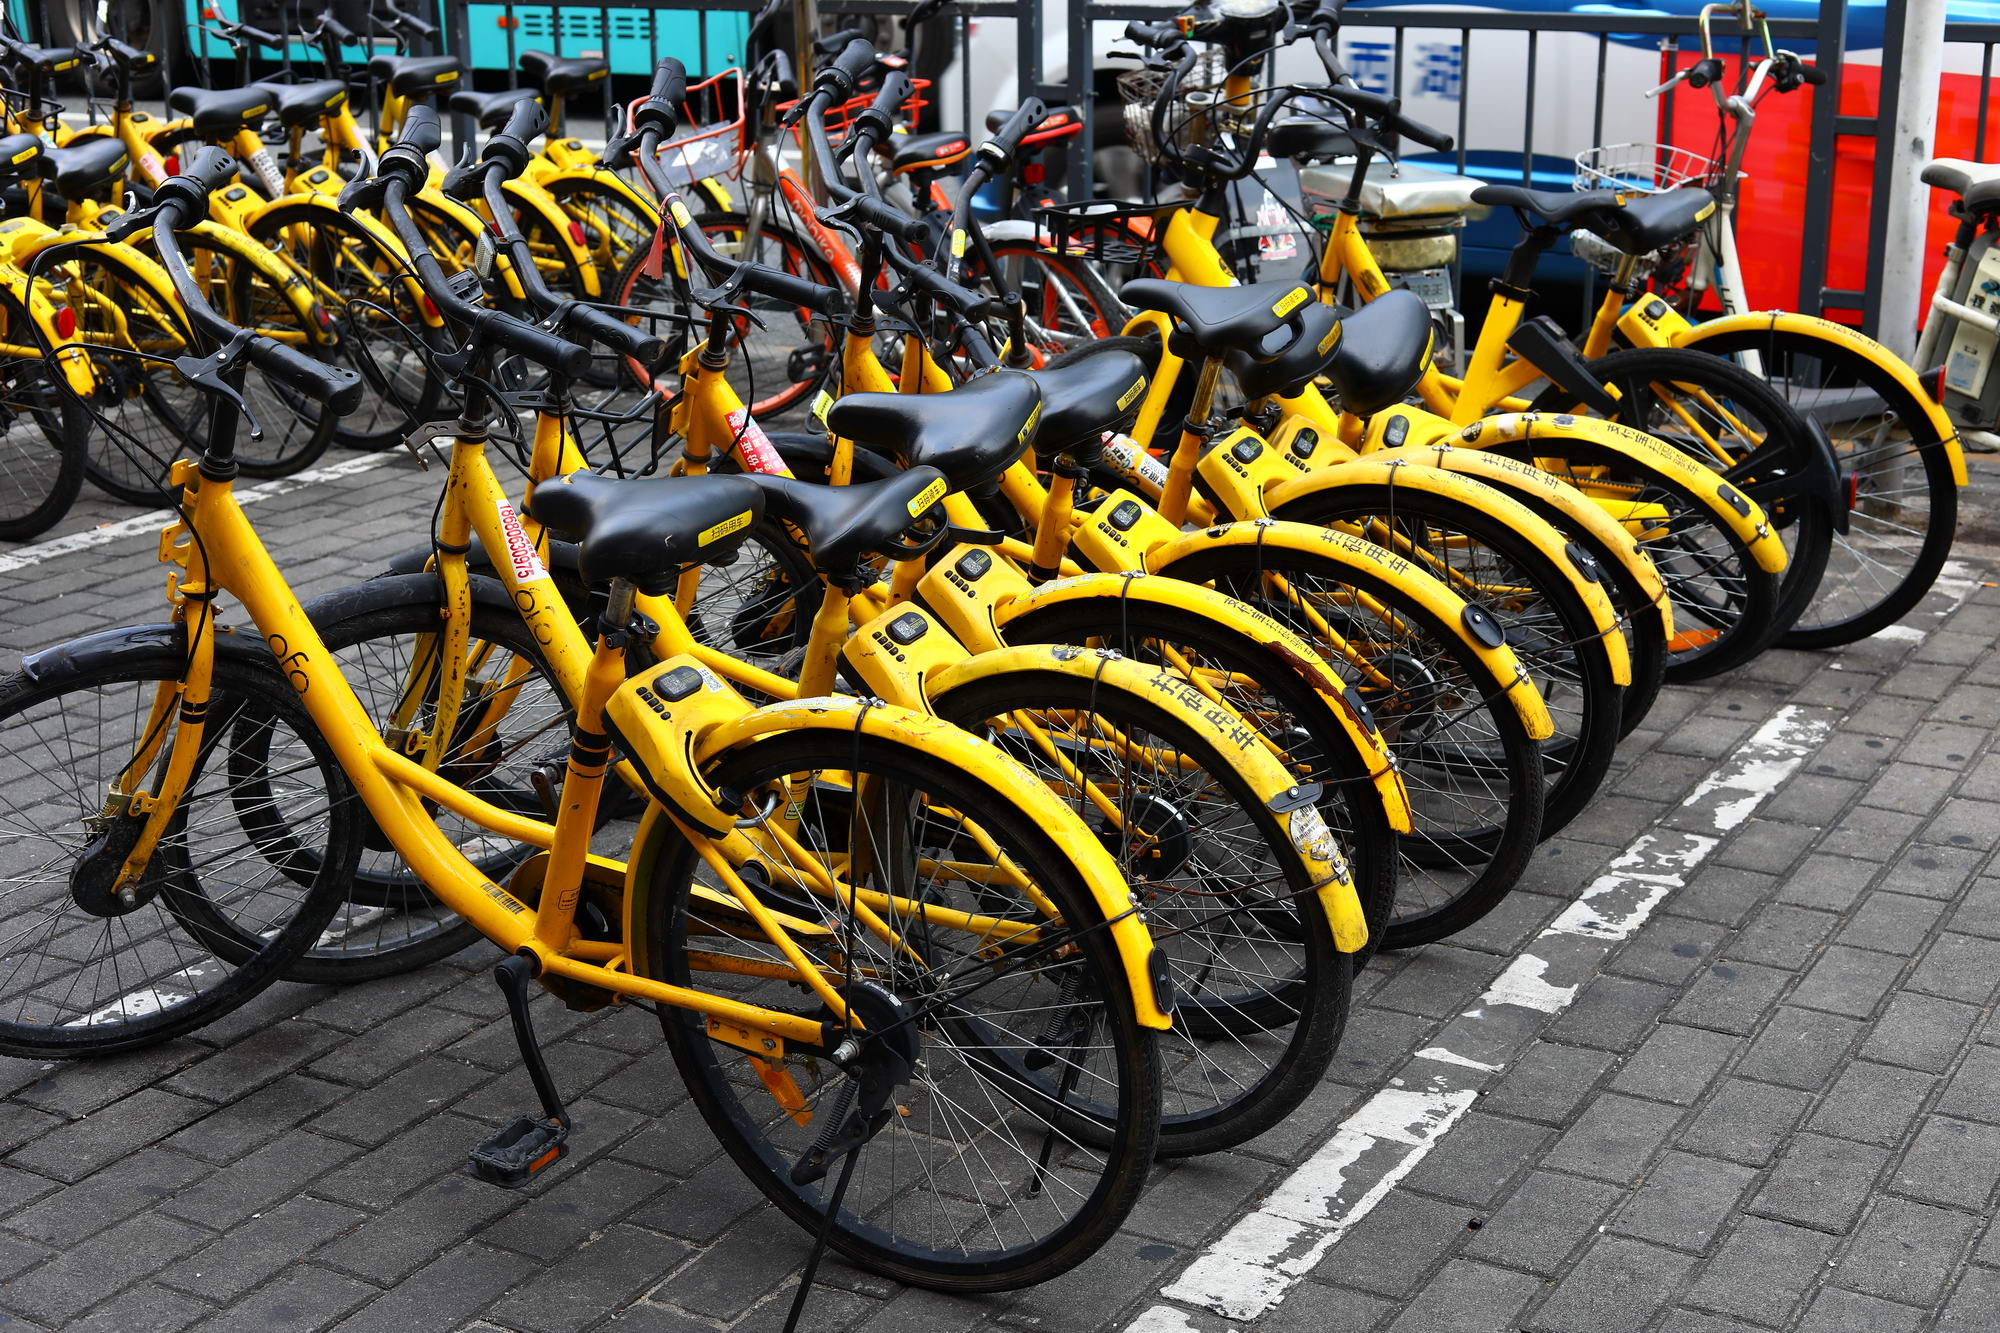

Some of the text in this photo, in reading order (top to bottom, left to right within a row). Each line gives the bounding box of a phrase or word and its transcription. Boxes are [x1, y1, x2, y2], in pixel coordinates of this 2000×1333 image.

[791, 199, 835, 263] mobike
[1482, 452, 1561, 489] 扫码用车
[499, 504, 536, 579] 18680630975
[710, 517, 744, 540] 扫码用车
[1320, 528, 1409, 576] 扫码用车
[268, 633, 310, 694] ofo
[1149, 672, 1256, 752] 扫码用车
